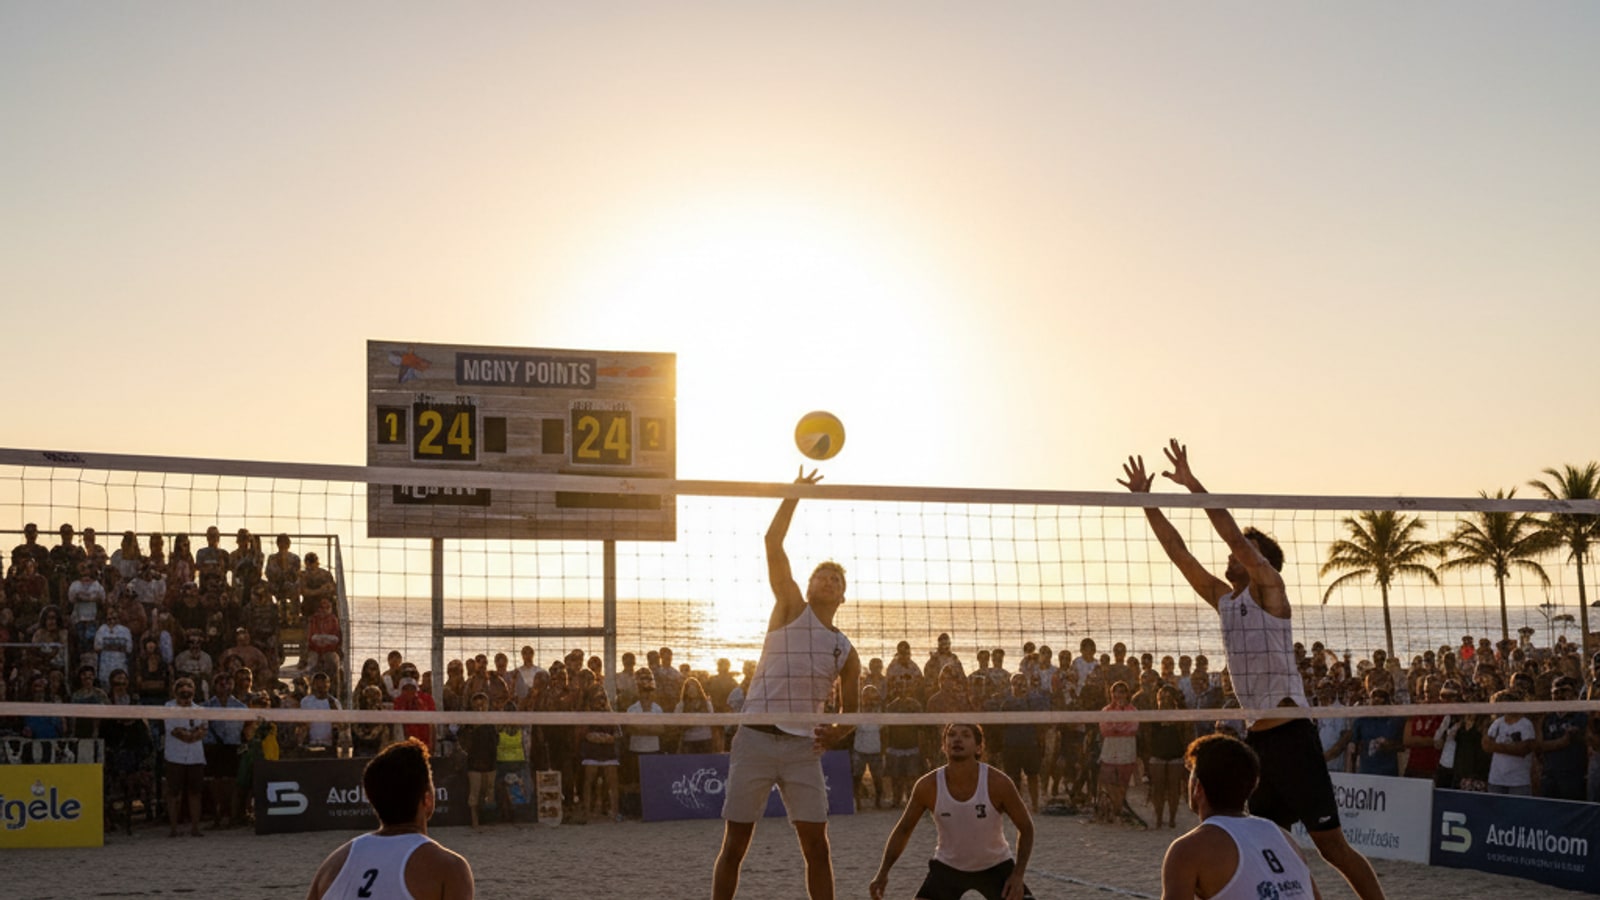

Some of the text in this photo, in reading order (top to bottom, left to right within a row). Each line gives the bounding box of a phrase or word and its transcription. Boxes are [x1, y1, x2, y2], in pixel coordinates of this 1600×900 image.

[463, 359, 591, 385] MGNY POINTS
[418, 410, 473, 455] 24
[577, 415, 631, 459] 24
[357, 868, 379, 898] 2
